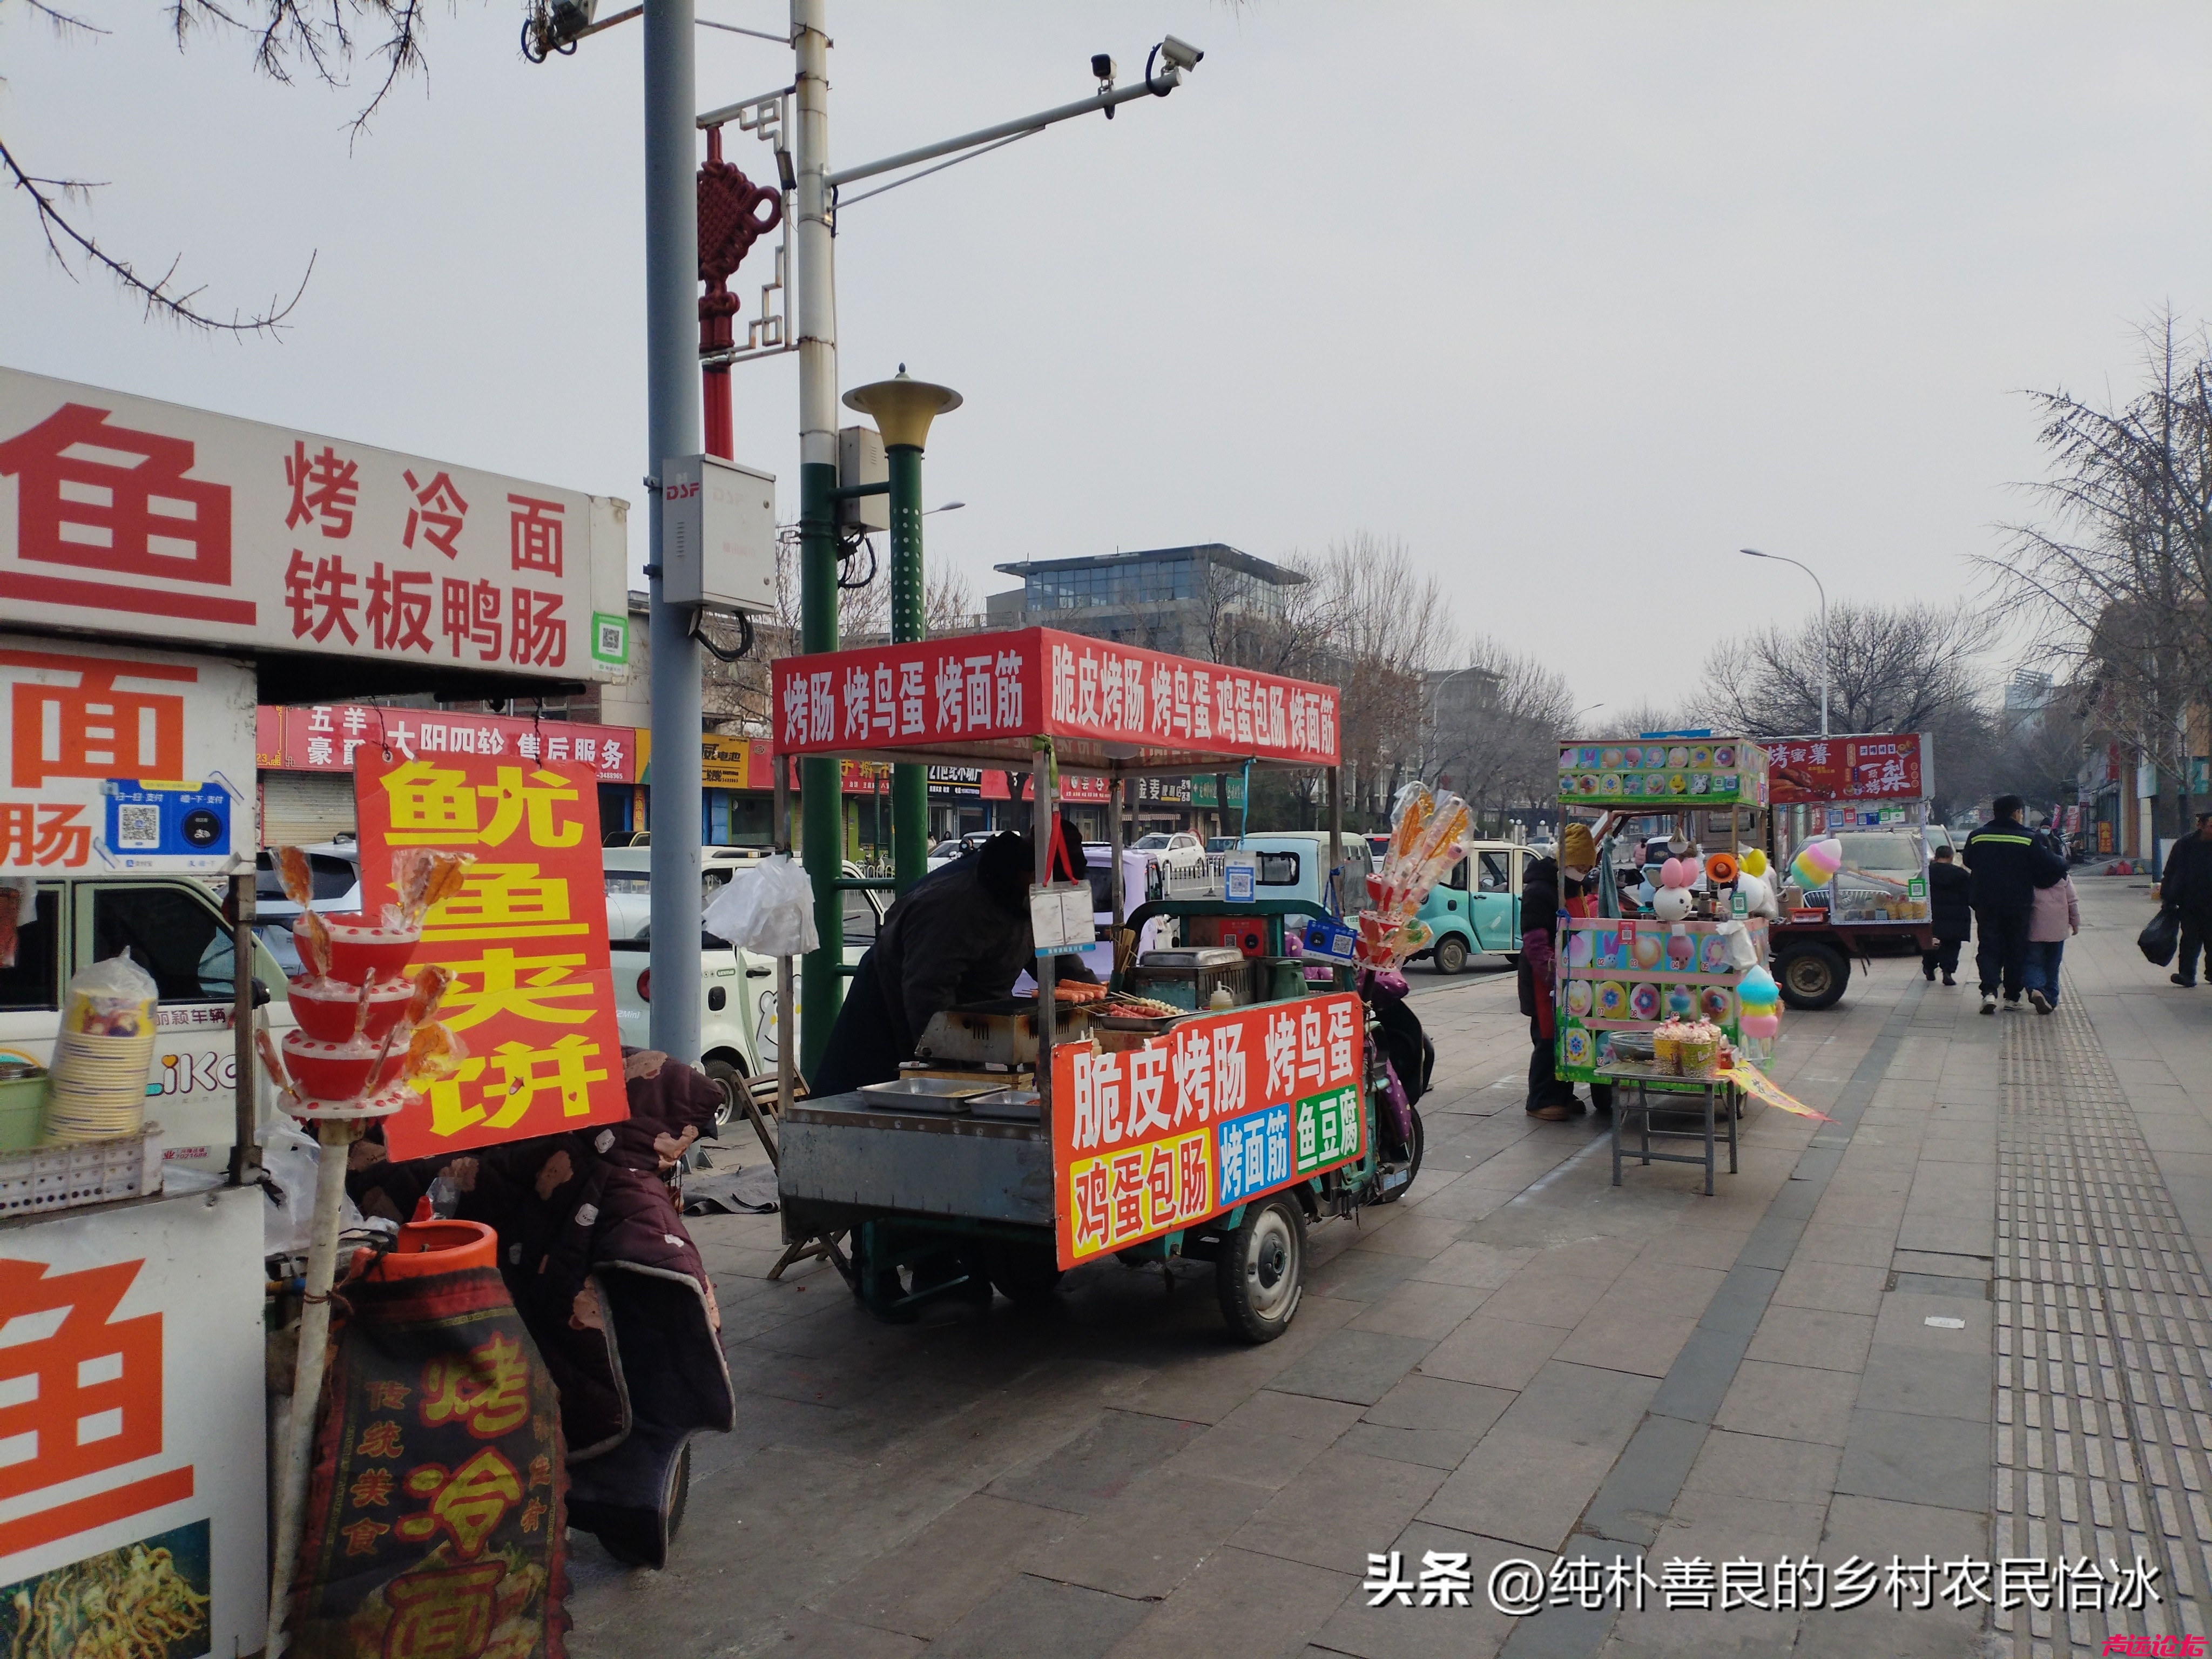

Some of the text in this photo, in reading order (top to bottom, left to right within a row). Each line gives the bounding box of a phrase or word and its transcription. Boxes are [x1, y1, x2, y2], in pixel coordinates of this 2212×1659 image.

[0, 402, 257, 626] 鱼
[284, 440, 565, 578] 烤冷面
[666, 482, 699, 500] DSF
[284, 548, 567, 668] 铁板鸭肠
[0, 650, 198, 788] 面
[308, 706, 367, 736] 五羊
[387, 721, 624, 770] 大阳四轮 售后服务
[784, 649, 1023, 746] 烤肠 烤鸟蛋 烤面筋
[1051, 643, 1335, 756] 脆皮烤肠 烤鸟蛋 鸡蛋包肠 烤面筋
[1768, 743, 1832, 769] 烤蜜薯
[0, 802, 91, 868] 肠
[156, 1008, 226, 1026] 丽颖车辆
[1072, 1001, 1354, 1150] 脆皮烤肠 烤鸟蛋
[1297, 1088, 1359, 1170] 鱼豆腐
[1074, 1135, 1208, 1250] 鸡蛋包肠
[1219, 1104, 1289, 1202] 烤面筋
[0, 1257, 194, 1556] 鱼
[341, 1379, 411, 1557] 传统美食
[382, 1330, 531, 1659] 烤冷面
